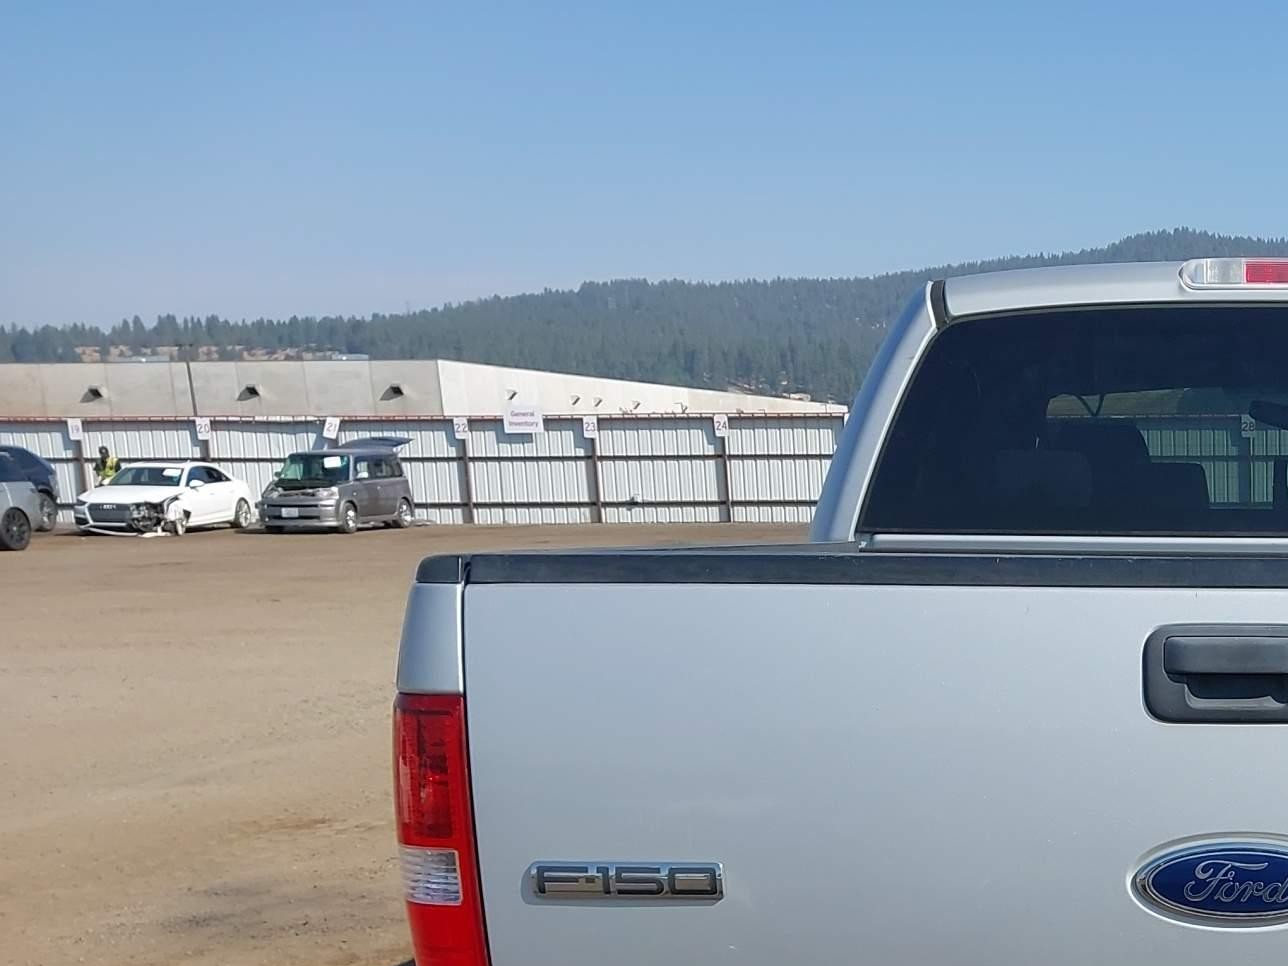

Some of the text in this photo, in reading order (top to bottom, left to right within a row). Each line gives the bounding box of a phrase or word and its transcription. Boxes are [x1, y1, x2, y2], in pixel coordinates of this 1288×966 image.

[197, 423, 210, 434] 20
[326, 422, 337, 432] 21
[455, 423, 468, 433] 22
[584, 422, 596, 432] 23
[715, 420, 727, 431] 24
[1241, 421, 1255, 432] 28
[536, 865, 718, 895] F-150
